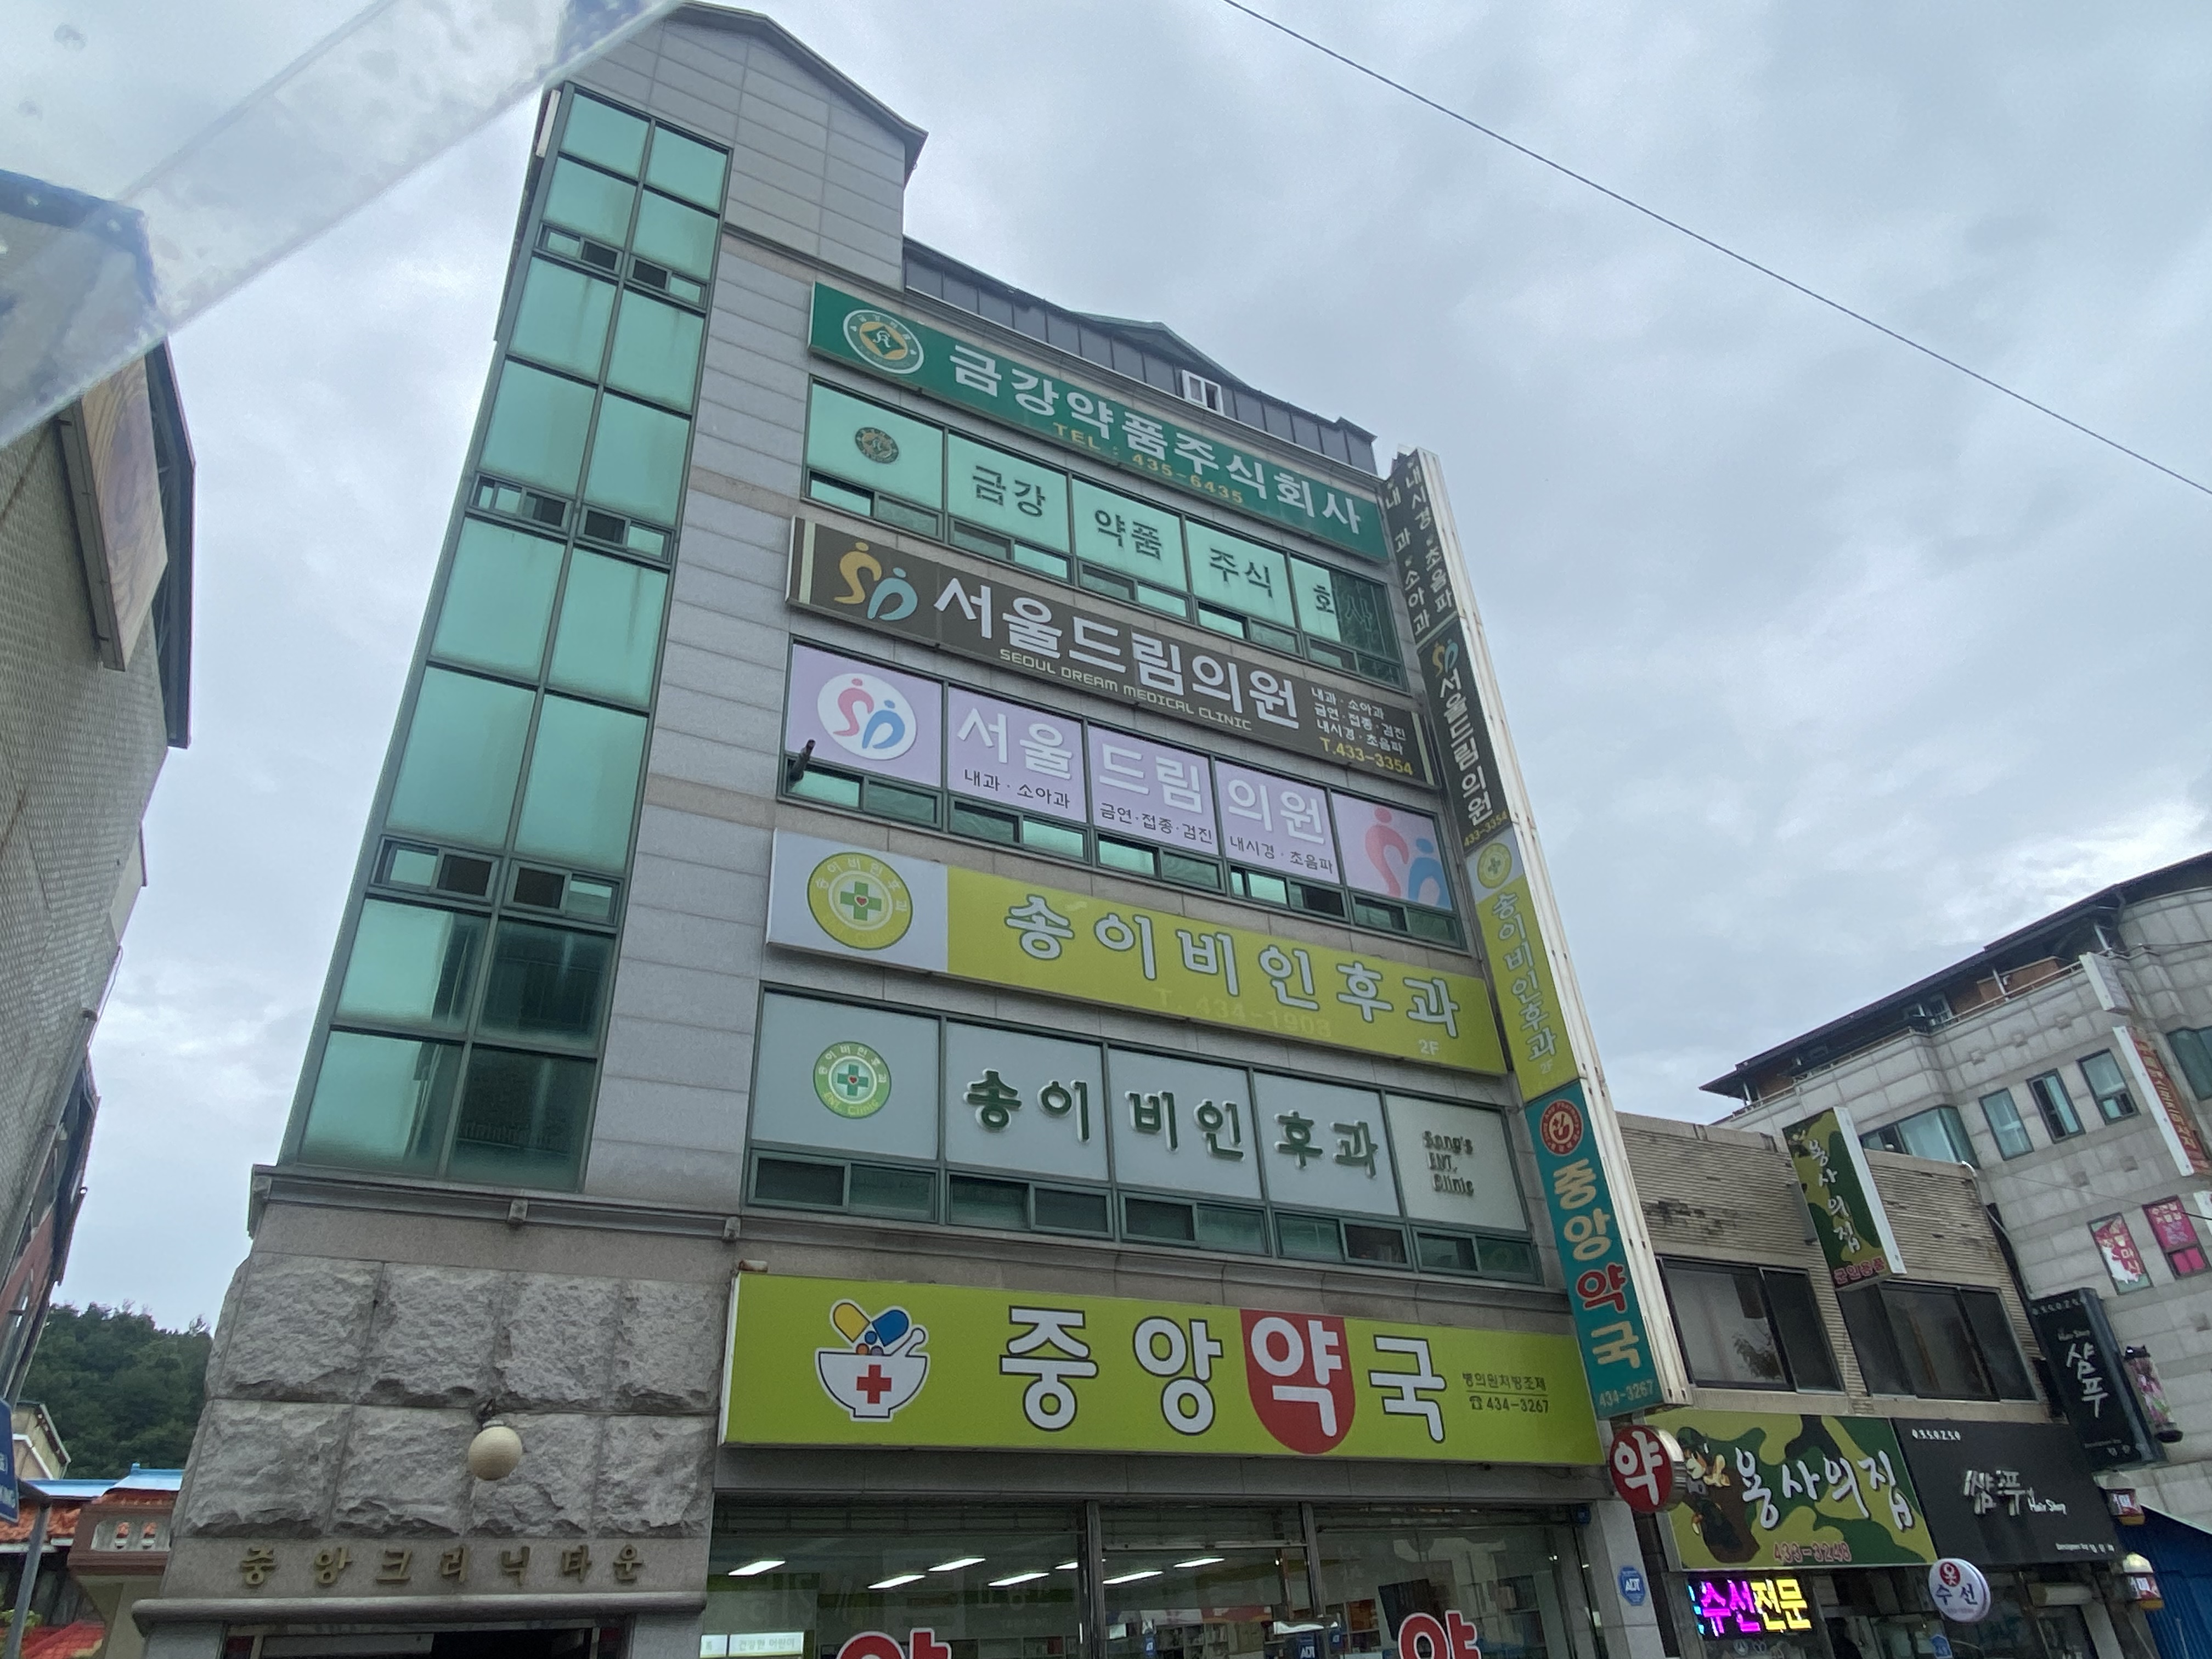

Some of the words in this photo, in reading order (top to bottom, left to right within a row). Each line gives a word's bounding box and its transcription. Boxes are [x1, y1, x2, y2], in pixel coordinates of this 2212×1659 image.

[950, 345, 1361, 534] 금강약품주식회사
[1053, 422, 1101, 450] TEL
[1132, 453, 1244, 504] 435-6435
[972, 466, 1046, 517] 금강
[1094, 510, 1162, 561] 약품
[1209, 547, 1273, 599] 주식
[1405, 569, 1431, 636] 소아과
[934, 577, 1299, 730] 서울드림의원
[1000, 648, 1056, 675] SEOUL
[1061, 668, 1118, 693] DREAM
[1123, 685, 1195, 715] MEDICAL
[1198, 707, 1252, 731] CLINIC
[957, 708, 1073, 780] 서울
[1099, 743, 1203, 814] 드림
[1228, 779, 1325, 845] 의원
[1440, 666, 1493, 826] 서울드림의원
[1464, 809, 1509, 847] 433-3354
[1005, 893, 1460, 1039] 송이비인후과
[1492, 891, 1558, 1063] 송이비인후과
[1419, 1039, 1438, 1054] 2F
[1540, 1059, 1554, 1073] 2F
[1433, 1173, 1475, 1197] Clinic
[1553, 1158, 1641, 1369] 중앙약국
[998, 1305, 1448, 1444] 중앙약국
[1486, 1397, 1549, 1414] 434-3267
[1599, 1378, 1654, 1408] 434-3267
[1614, 1431, 1663, 1506] 약
[238, 1544, 646, 1587] 중앙크리닉타운
[1626, 1578, 1641, 1592] ADT
[1773, 1541, 1852, 1563] 433-3248
[1935, 1583, 1978, 1605] 수선
